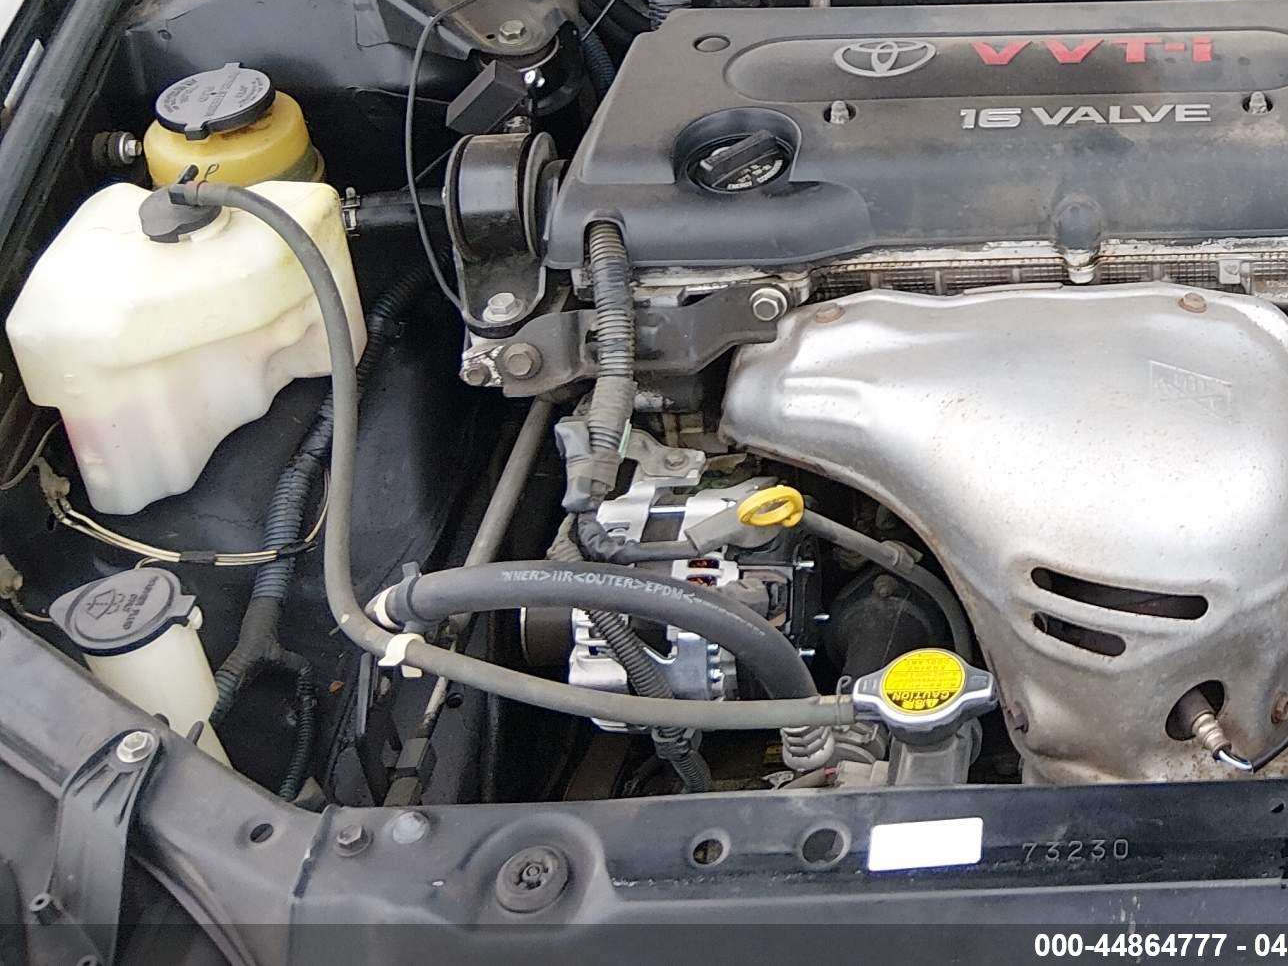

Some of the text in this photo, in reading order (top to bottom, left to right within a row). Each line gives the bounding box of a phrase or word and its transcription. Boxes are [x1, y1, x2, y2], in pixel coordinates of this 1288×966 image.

[960, 104, 1212, 130] 16 VALVE
[892, 690, 951, 704] CAUTION
[1021, 838, 1130, 863] 73230
